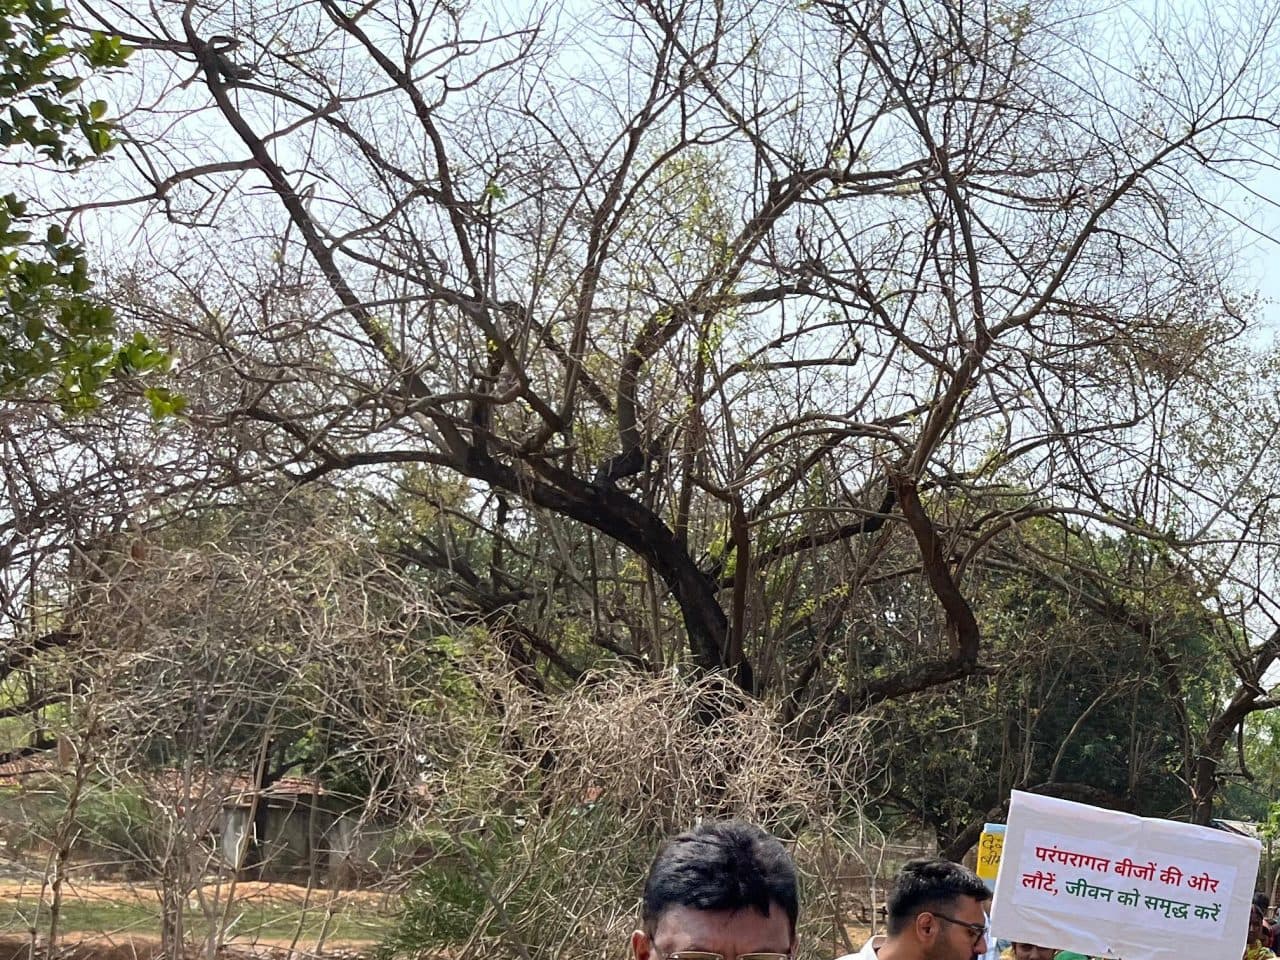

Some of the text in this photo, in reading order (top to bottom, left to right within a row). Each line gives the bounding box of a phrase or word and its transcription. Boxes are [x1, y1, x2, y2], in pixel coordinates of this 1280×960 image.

[1036, 845, 1219, 893] परंपरागत बीजों की ओर
[1022, 871, 1222, 923] लौटें, जीवन को समृद्ध करें
